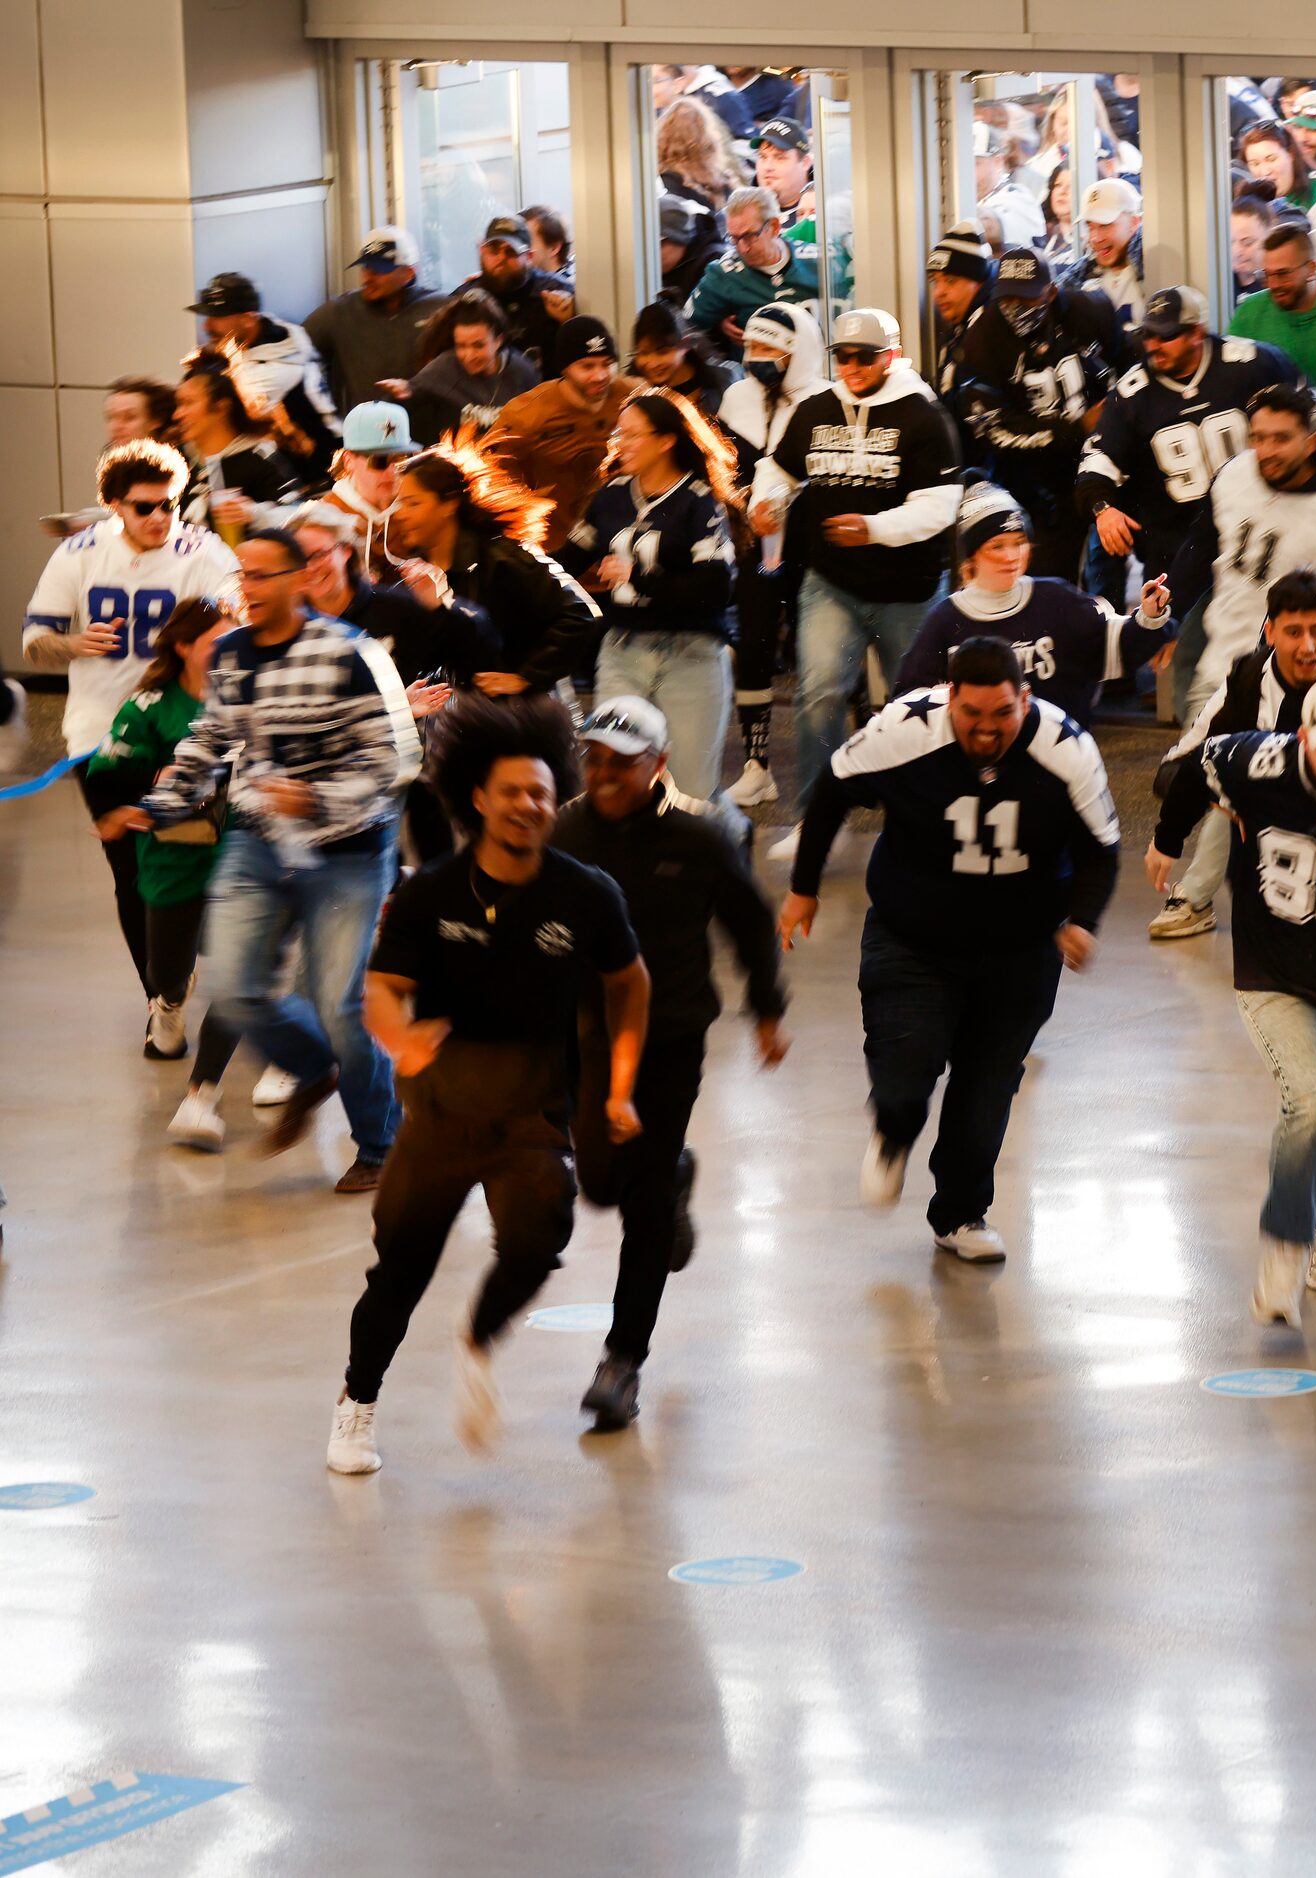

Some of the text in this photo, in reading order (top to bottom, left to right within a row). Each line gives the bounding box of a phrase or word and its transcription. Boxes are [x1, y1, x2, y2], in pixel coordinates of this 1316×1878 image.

[1150, 407, 1250, 503] 90
[88, 585, 177, 660] 88
[943, 795, 1030, 876] 11
